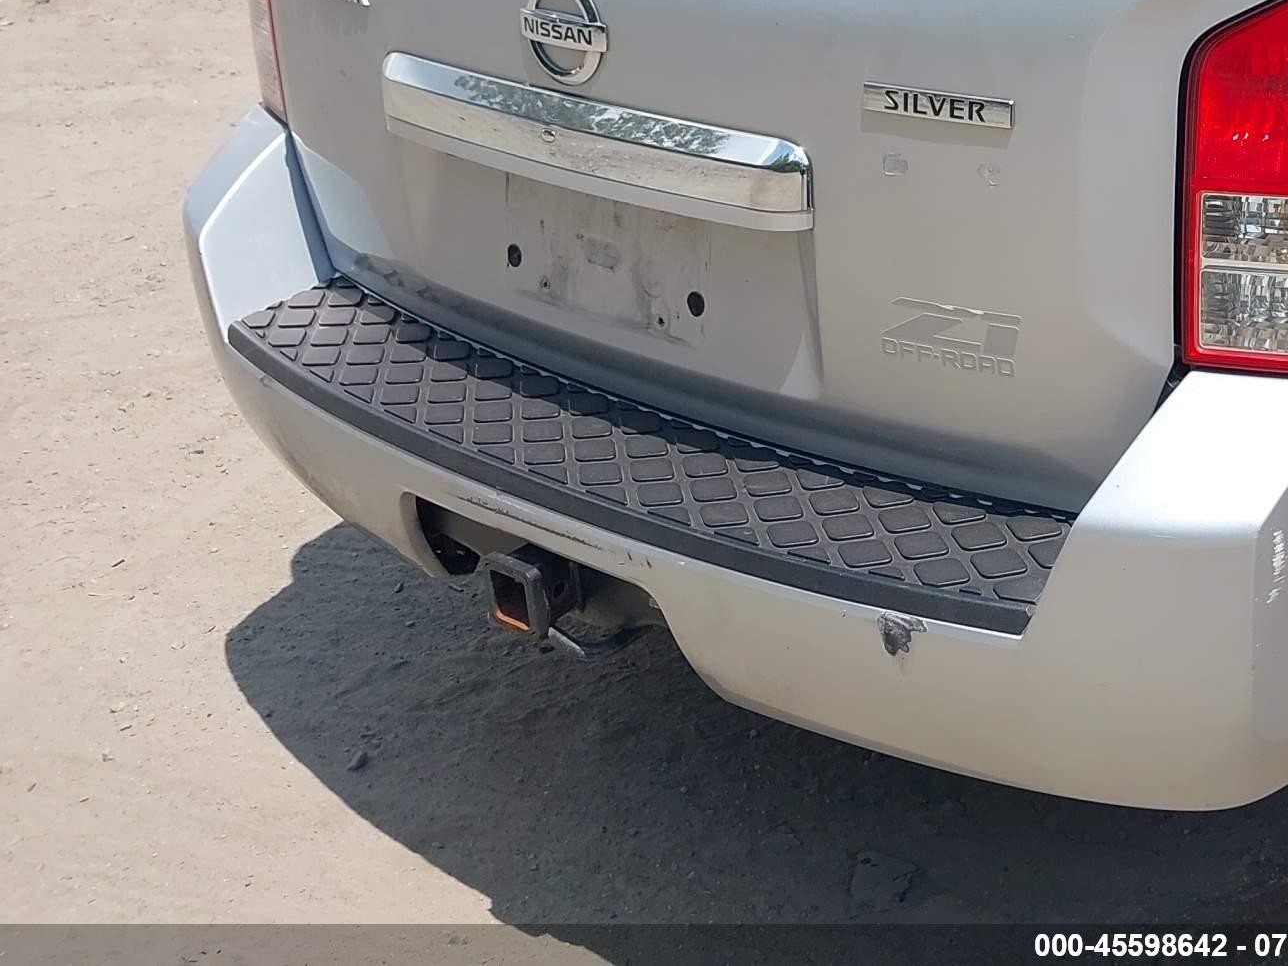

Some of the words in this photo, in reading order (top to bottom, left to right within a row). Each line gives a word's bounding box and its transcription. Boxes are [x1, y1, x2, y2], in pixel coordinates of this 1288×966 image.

[523, 16, 593, 46] NISSAN
[884, 90, 986, 123] SILVER
[881, 336, 1016, 378] OFF-ROAD
